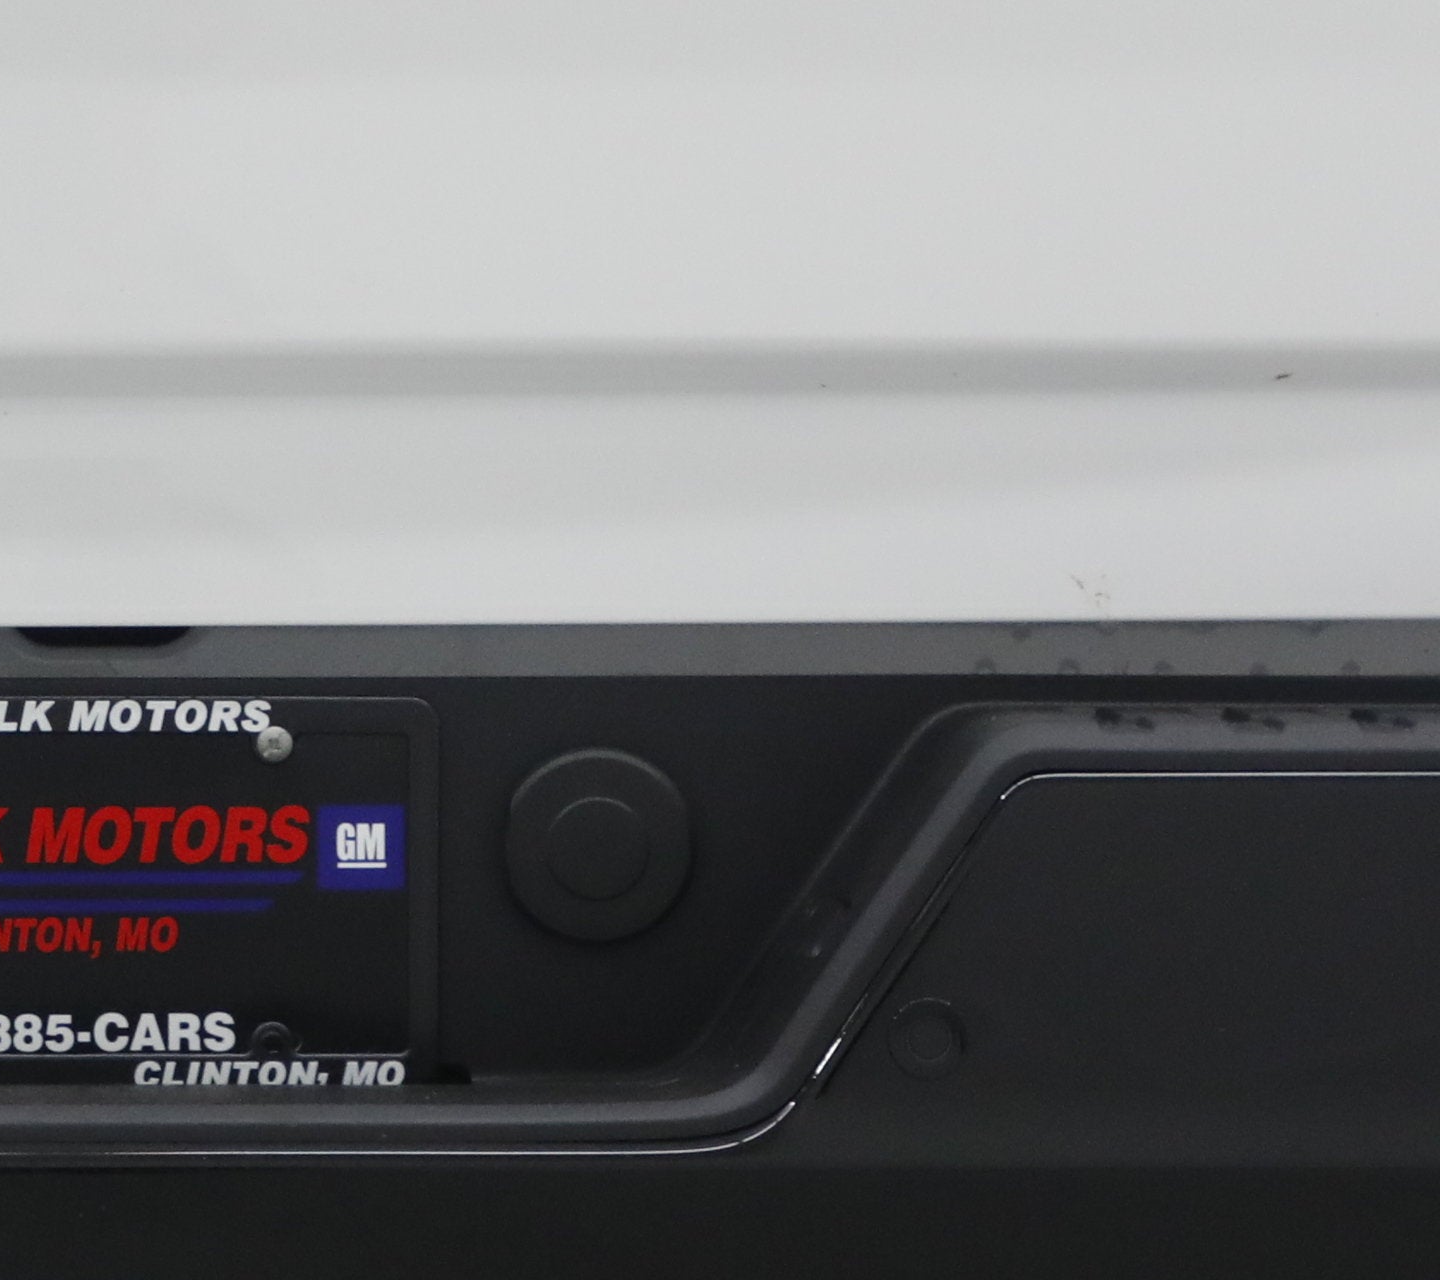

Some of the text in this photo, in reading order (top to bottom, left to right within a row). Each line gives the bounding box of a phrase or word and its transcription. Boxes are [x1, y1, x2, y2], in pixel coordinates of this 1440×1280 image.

[68, 699, 273, 733] MOTORS
[25, 805, 311, 866] MOTORS
[335, 822, 387, 863] GM
[115, 915, 180, 953] MO
[342, 1060, 407, 1087] MO
